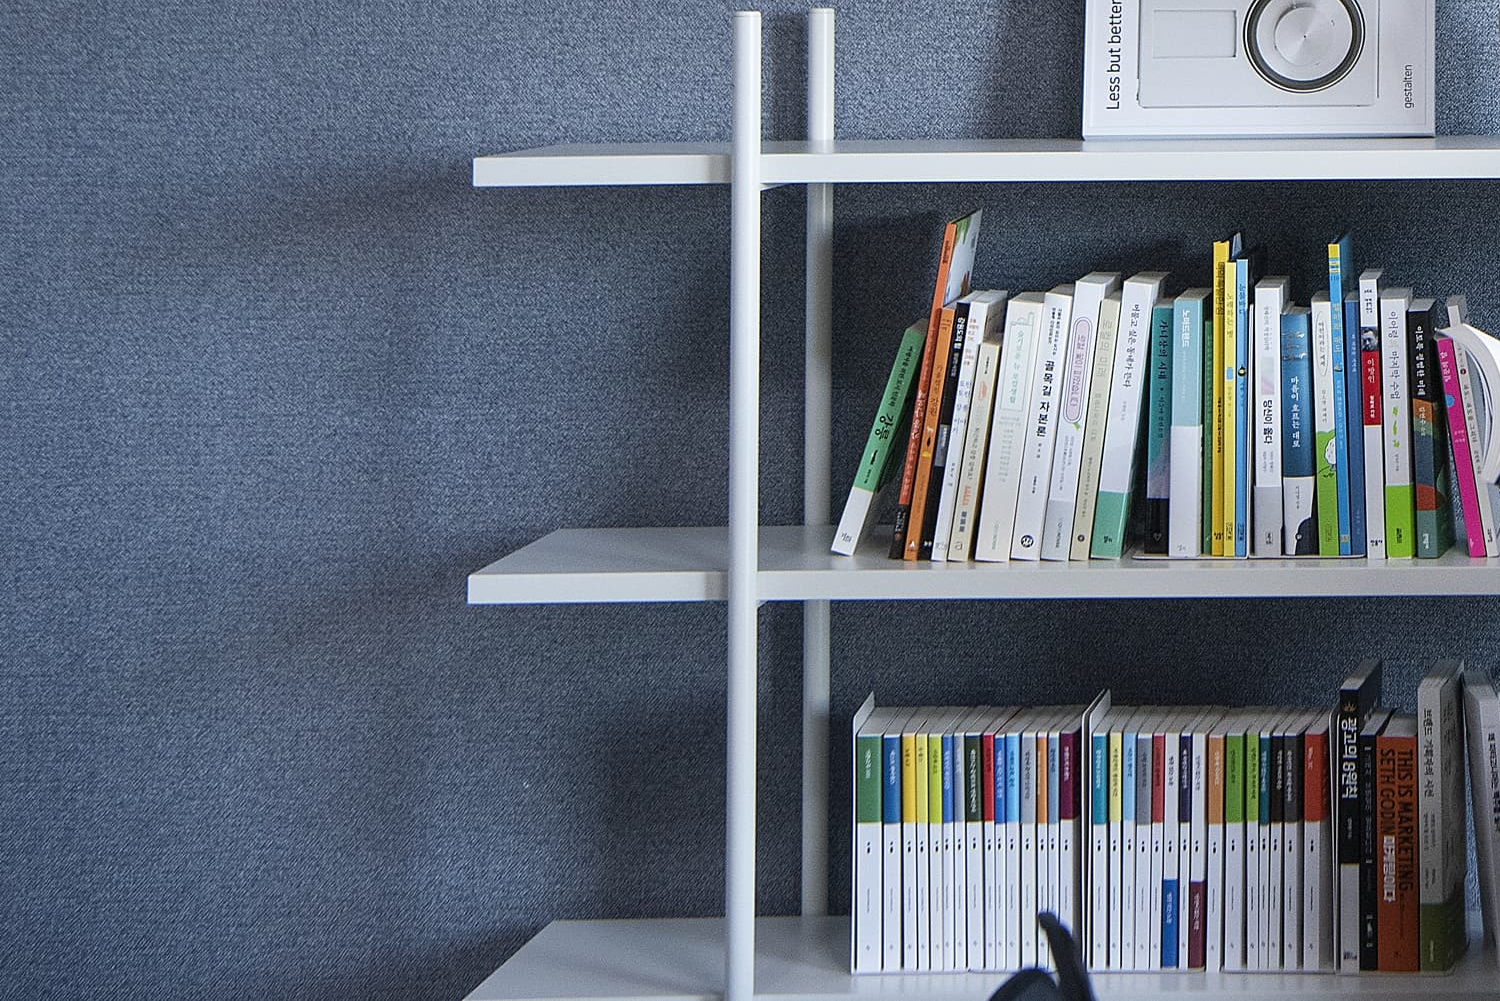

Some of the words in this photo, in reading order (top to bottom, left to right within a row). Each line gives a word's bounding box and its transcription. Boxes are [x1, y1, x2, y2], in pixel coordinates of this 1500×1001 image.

[1109, 0, 1123, 43] better
[1108, 45, 1121, 75] but
[1106, 77, 1120, 110] Less
[1403, 64, 1414, 109] gestalten
[1181, 310, 1191, 347] 노마드랜드
[1415, 326, 1423, 350] 이토록
[1157, 361, 1167, 379] 시대
[1389, 351, 1399, 378] 마지막
[1415, 352, 1424, 376] 평범한
[1040, 360, 1055, 397] 골목길
[1290, 375, 1298, 400] 마음이
[1390, 381, 1399, 399] 수업
[1416, 379, 1424, 395] 미래
[1035, 401, 1050, 438] 자본론
[1263, 399, 1272, 423] 당신이
[1291, 403, 1299, 428] 흐르는
[873, 411, 896, 441] 강릉
[1263, 427, 1272, 444] 옳다
[1292, 431, 1299, 447] 대로
[1423, 709, 1432, 735] 브랜드
[1341, 716, 1357, 758] 광고의
[1379, 748, 1395, 785] SETH
[1396, 748, 1413, 780] THIS
[1397, 784, 1413, 796] IS
[1380, 788, 1396, 834] GODIN
[1397, 801, 1414, 890] MARKETING
